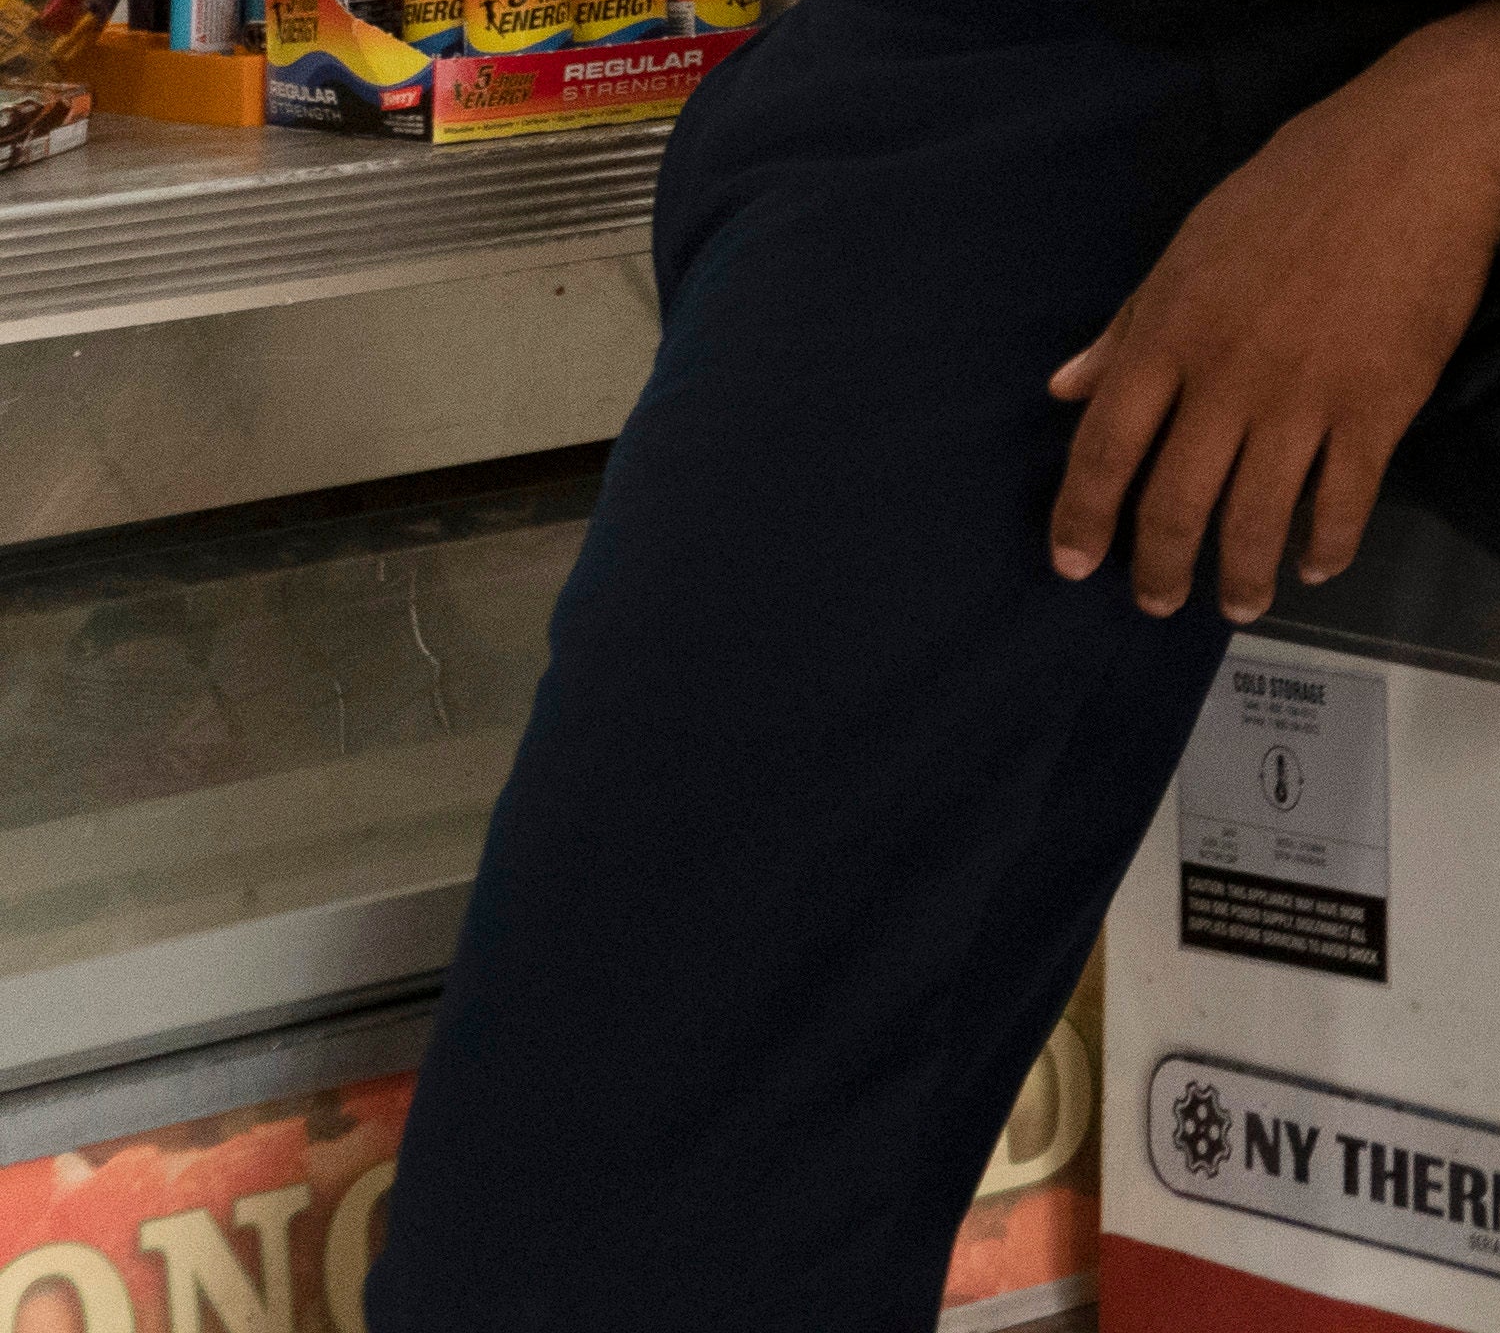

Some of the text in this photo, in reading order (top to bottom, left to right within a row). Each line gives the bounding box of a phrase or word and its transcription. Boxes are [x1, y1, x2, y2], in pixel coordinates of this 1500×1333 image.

[563, 49, 704, 83] REGULAR
[269, 77, 338, 107] REGULAR
[561, 71, 702, 102] STRENGTH
[1232, 670, 1327, 707] COLD STORAGE
[1245, 1110, 1321, 1184] NY
